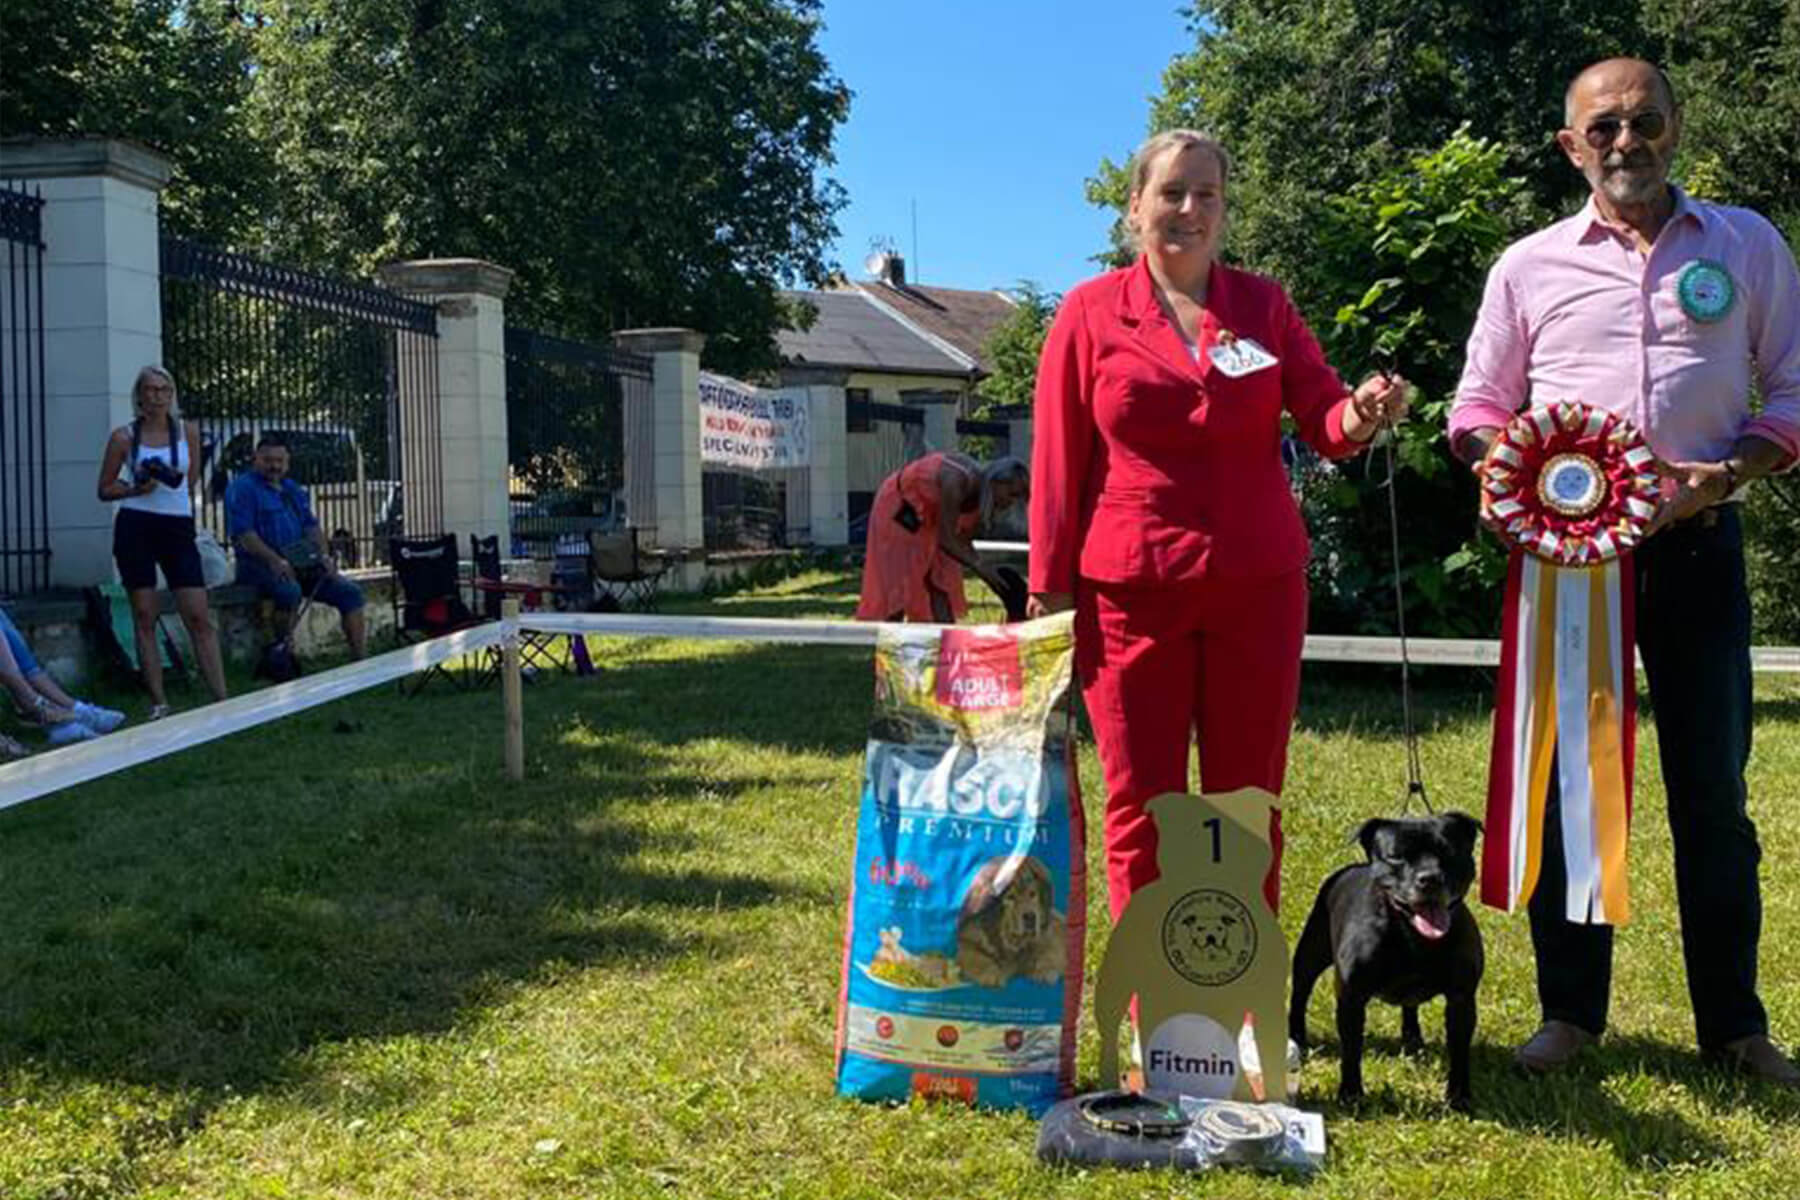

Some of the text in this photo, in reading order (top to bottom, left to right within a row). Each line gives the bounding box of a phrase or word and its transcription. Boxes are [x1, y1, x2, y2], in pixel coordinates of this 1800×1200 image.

[951, 674, 1010, 695] ADULT
[1203, 818, 1221, 863] 1
[1150, 1050, 1235, 1077] Fitmin
